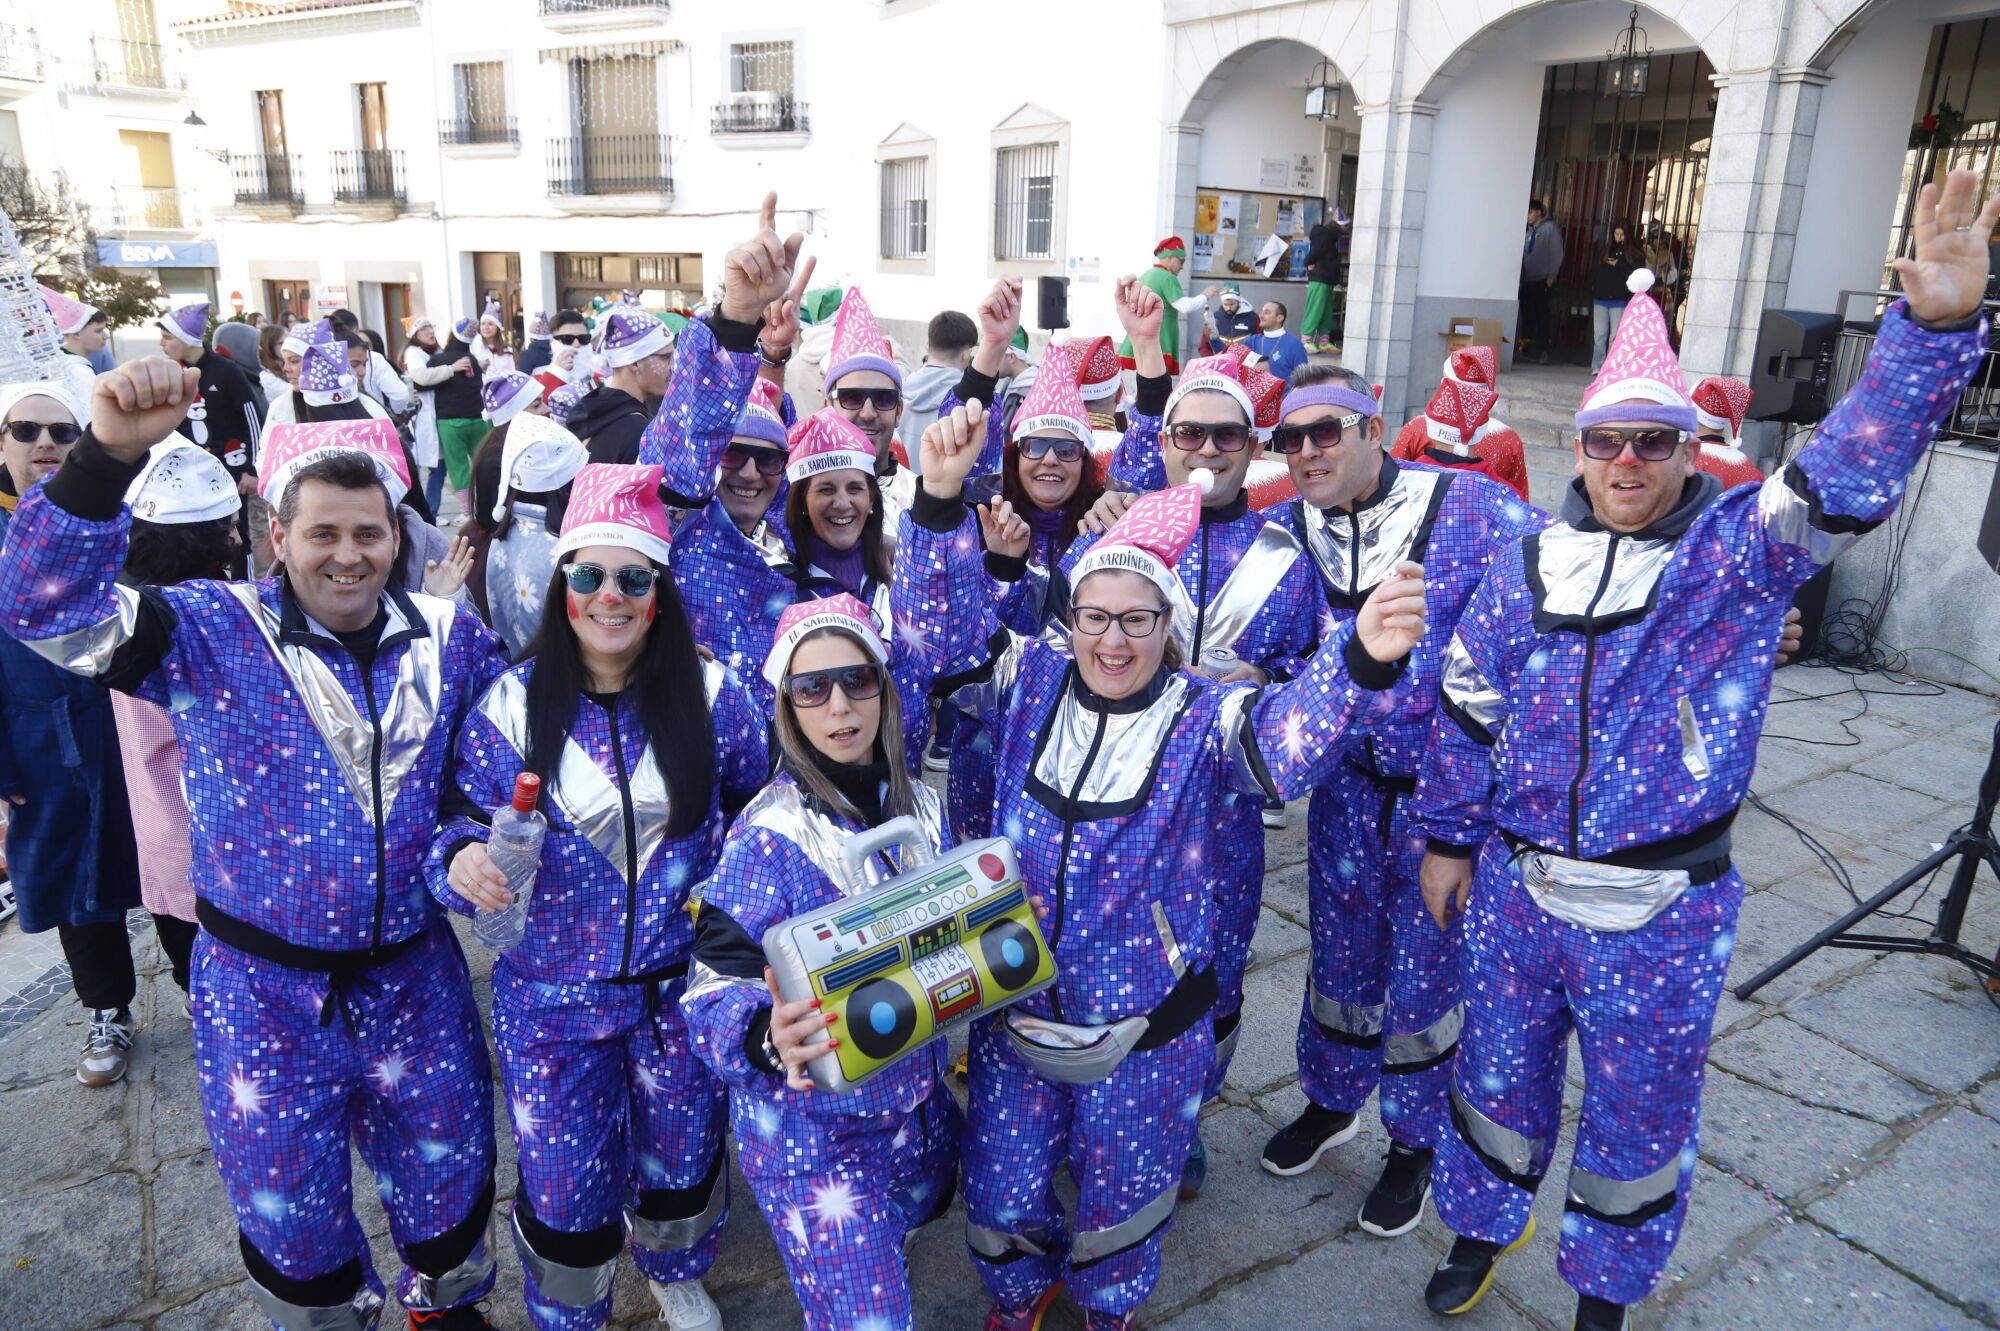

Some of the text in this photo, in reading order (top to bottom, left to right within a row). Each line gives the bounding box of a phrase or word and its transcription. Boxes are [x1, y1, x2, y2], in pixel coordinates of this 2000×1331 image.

[120, 244, 176, 262] BBVA
[799, 463, 807, 476] EL
[788, 629, 800, 644] EL
